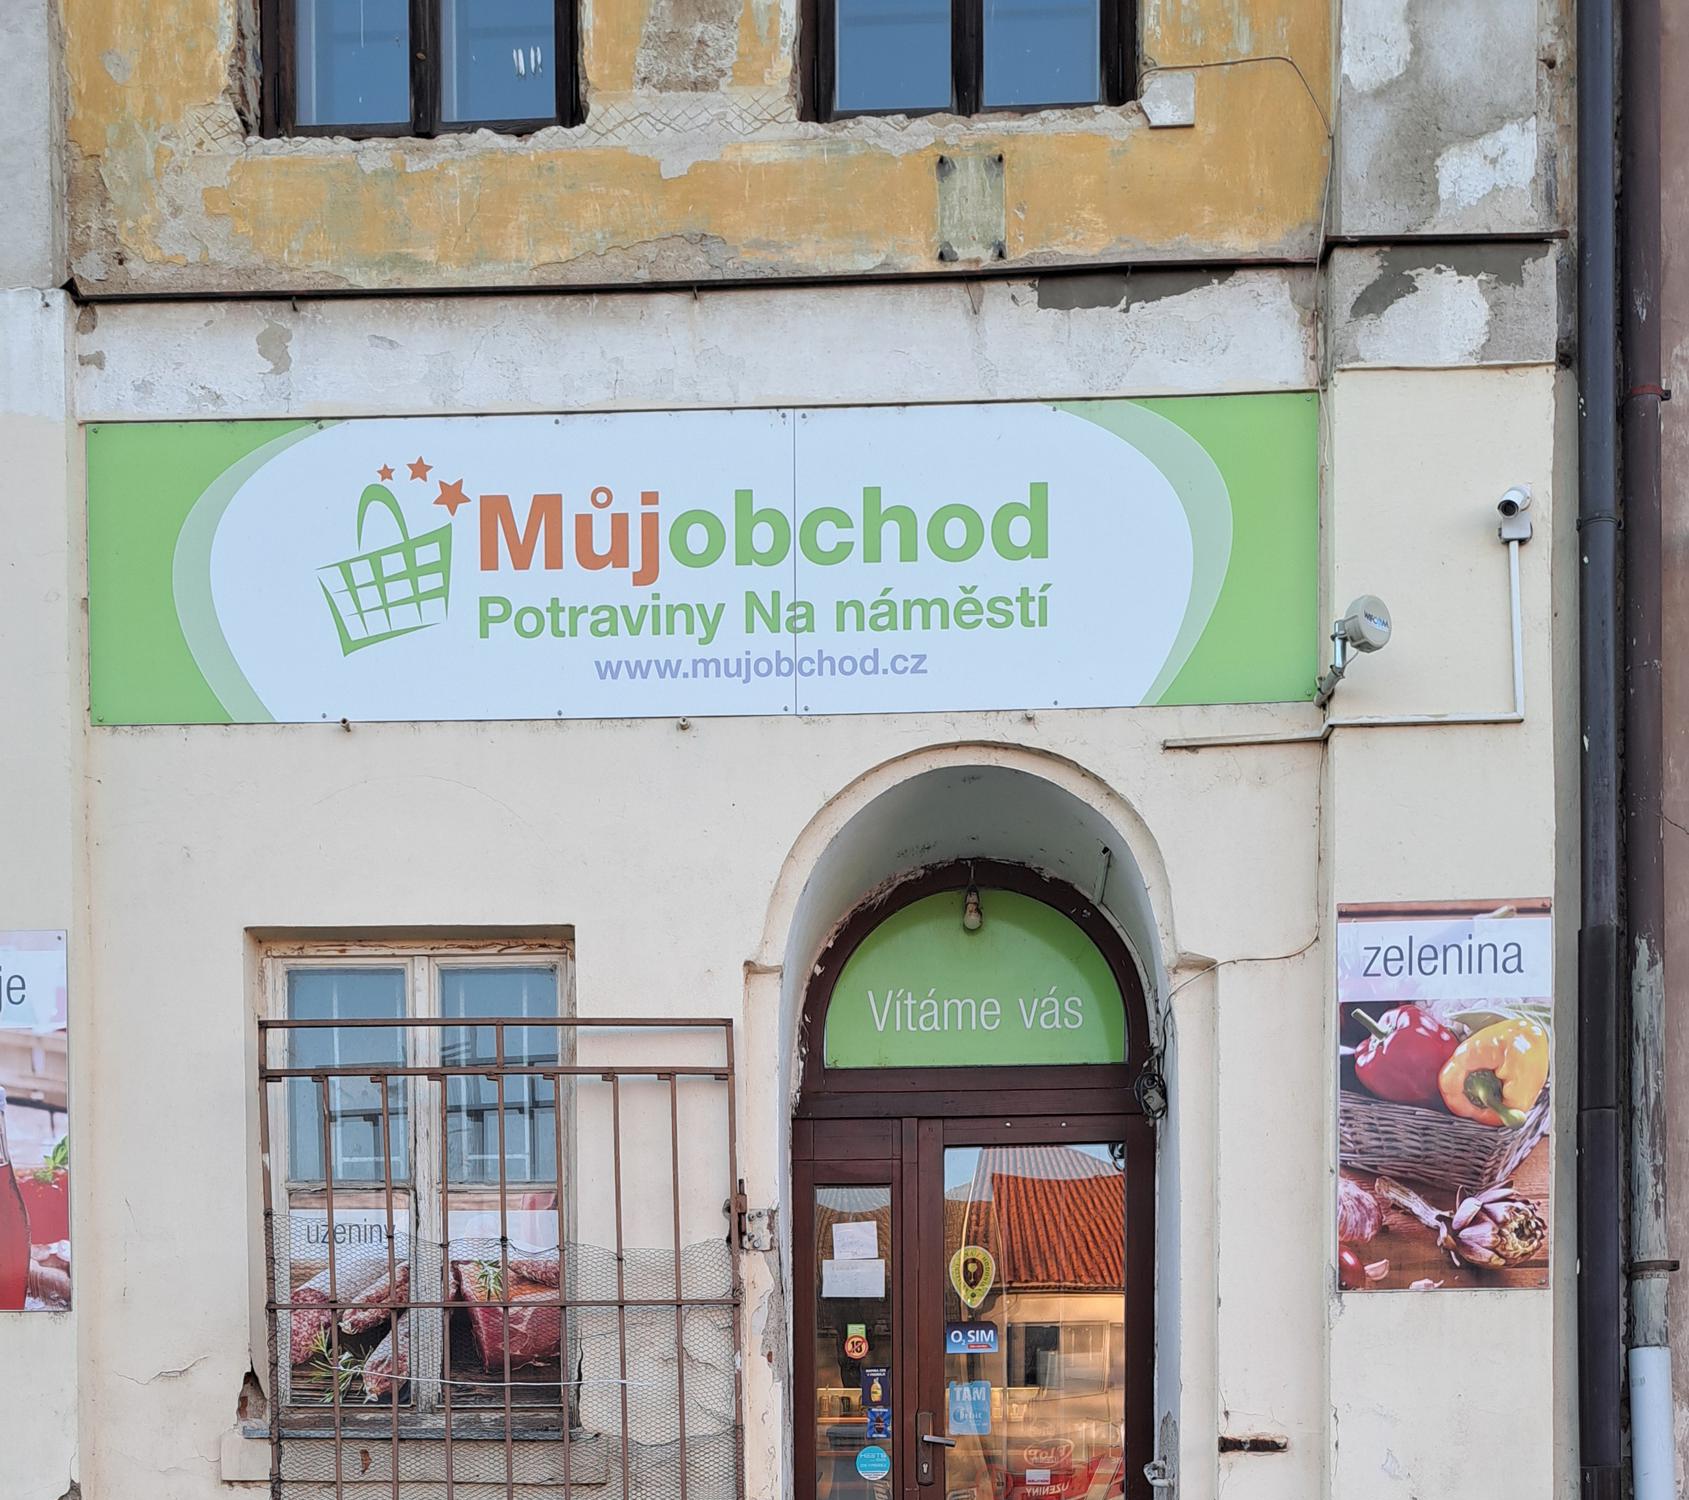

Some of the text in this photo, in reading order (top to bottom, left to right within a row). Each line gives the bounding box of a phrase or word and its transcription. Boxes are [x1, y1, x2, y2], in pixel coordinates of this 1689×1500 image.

[479, 482, 1049, 587] Můjobchod
[478, 583, 1053, 646] Potraviny Na náměstí
[594, 648, 928, 684] www.mujobchod.cz
[1362, 933, 1524, 977] zelenina
[867, 986, 1084, 1032] Vítáme vás
[967, 1329, 994, 1343] SIM
[954, 1386, 986, 1401] TAM
